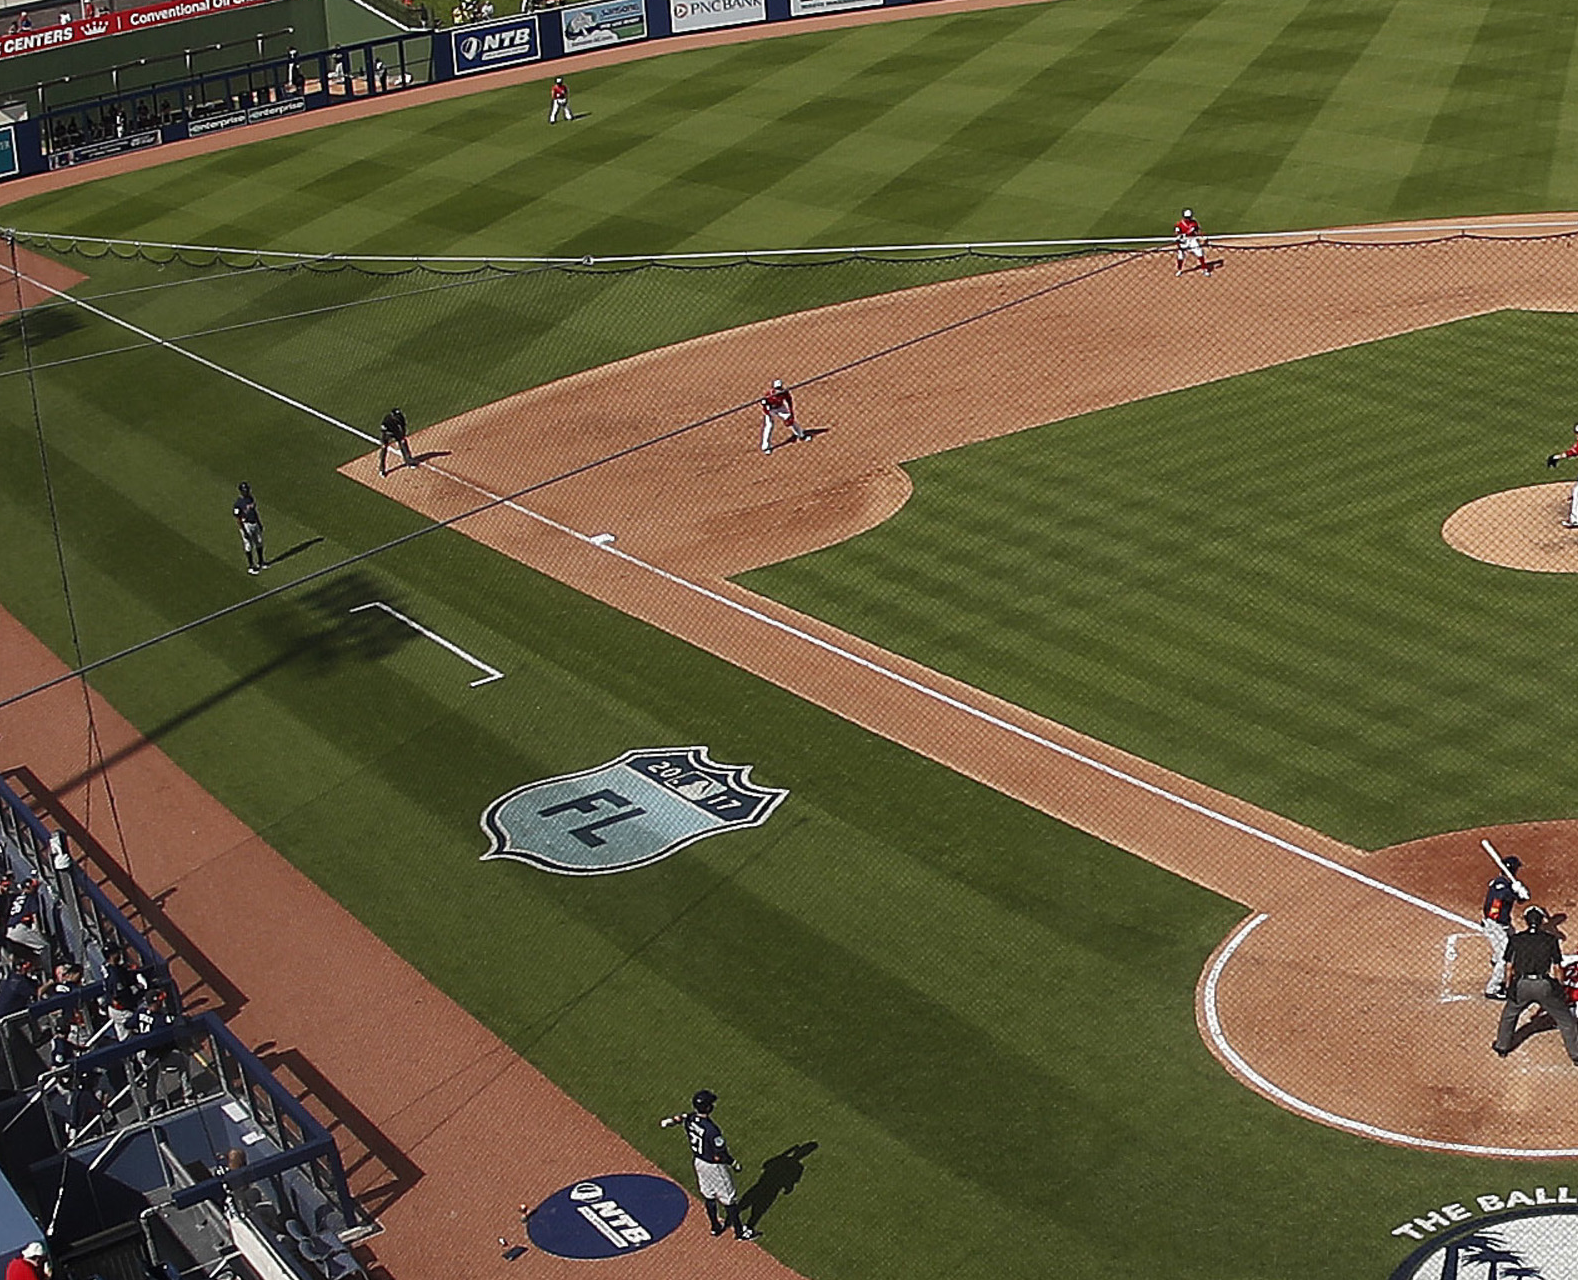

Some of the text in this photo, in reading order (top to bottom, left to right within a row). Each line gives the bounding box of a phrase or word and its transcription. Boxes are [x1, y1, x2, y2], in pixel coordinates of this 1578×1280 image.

[130, 0, 211, 26] Conventional
[4, 26, 73, 54] CENTERS
[482, 28, 531, 52] NTB
[250, 101, 304, 119] enterprise
[190, 115, 246, 133] enterprise
[648, 761, 681, 779] 20
[706, 795, 742, 811] 17
[537, 788, 647, 849] FL
[590, 1200, 652, 1244] NTB
[1391, 1202, 1473, 1242] THE
